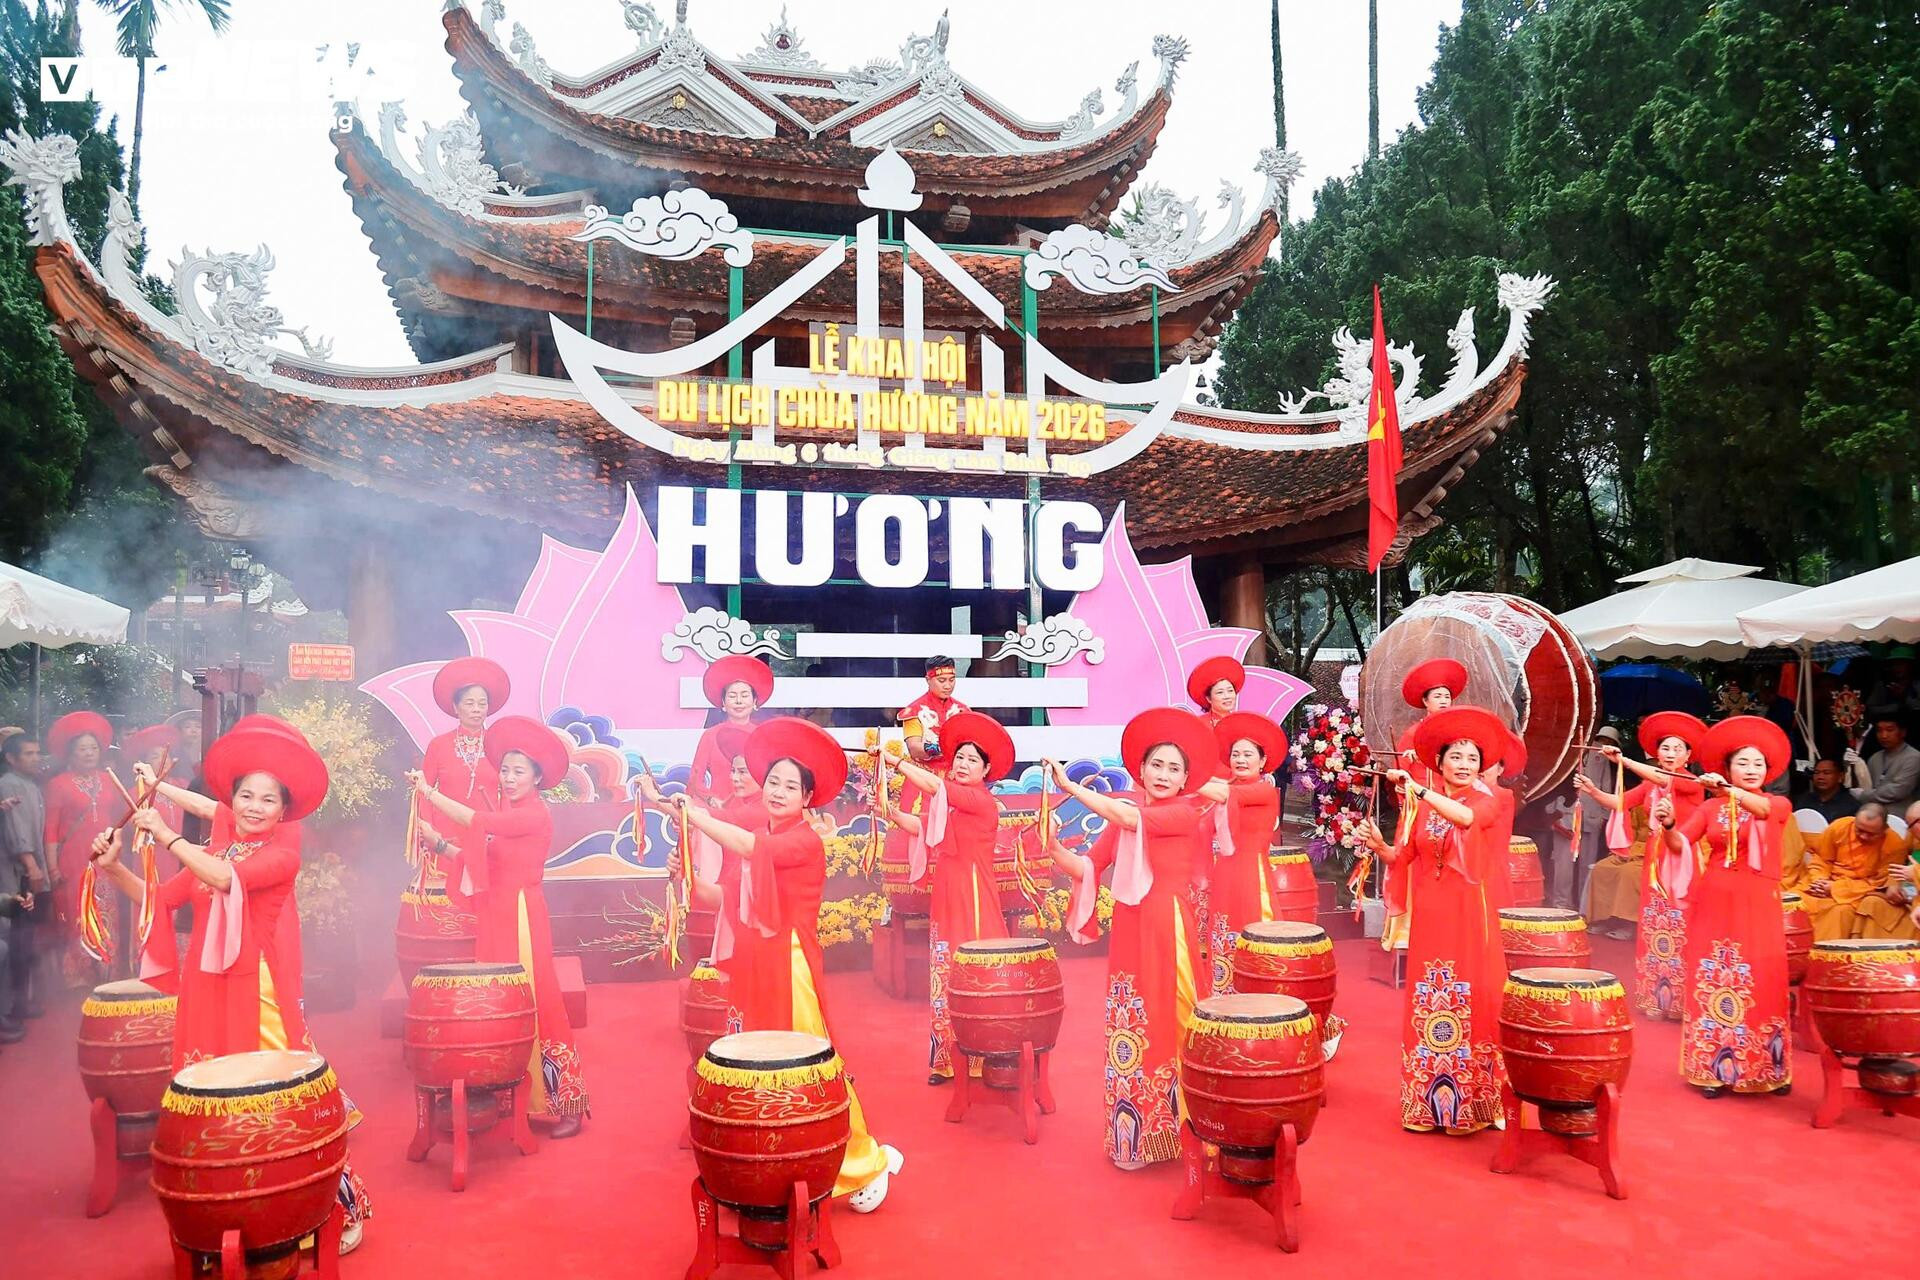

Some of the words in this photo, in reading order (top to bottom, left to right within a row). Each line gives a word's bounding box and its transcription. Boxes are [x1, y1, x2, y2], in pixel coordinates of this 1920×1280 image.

[809, 322, 840, 375] LỄ
[847, 335, 915, 379] KHAI
[921, 336, 966, 389] HỘI
[658, 380, 698, 423] DU
[707, 382, 770, 432] LỊCH
[778, 381, 855, 430] CHÙA
[862, 388, 958, 435] HƯƠNG
[965, 391, 1029, 438] NĂM
[1036, 401, 1106, 442] 2026
[656, 485, 1105, 591] HƯƠNG
